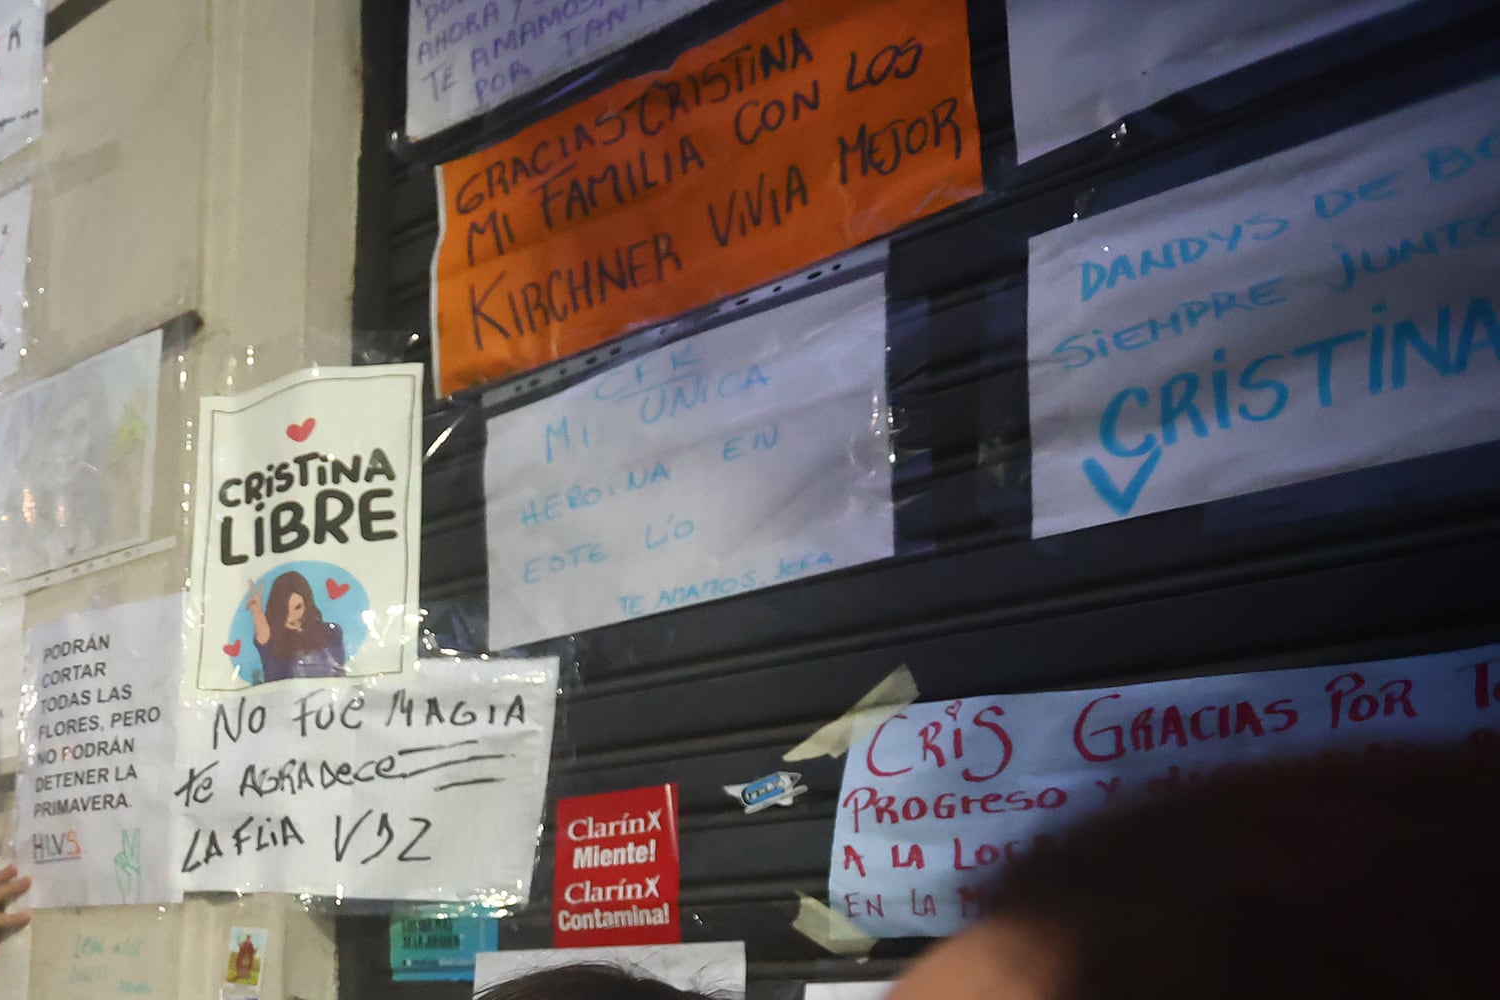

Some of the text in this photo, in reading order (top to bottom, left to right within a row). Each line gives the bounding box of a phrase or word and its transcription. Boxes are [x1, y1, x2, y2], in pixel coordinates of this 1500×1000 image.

[457, 28, 813, 216] GRACIAS CRISTINA
[467, 37, 923, 266] MI FAMILIA CON LOS
[470, 98, 963, 350] KIRCHNER VIVIA MEJOR
[1080, 211, 1289, 302] DANDYS
[1313, 173, 1399, 219] DE
[1051, 277, 1287, 369] SIEMPRE
[1100, 296, 1500, 458] CRISTINA
[546, 416, 589, 464] MI
[722, 424, 780, 462] EN
[43, 633, 111, 662] PODRÁN
[41, 662, 107, 689] CORTAR
[40, 684, 133, 714] TODAS LAS
[110, 706, 161, 728] PERO
[212, 697, 267, 750] NO
[385, 688, 526, 728] MAGIA
[866, 702, 1014, 783] CRIS
[1325, 672, 1419, 730] POR
[37, 735, 135, 767] NO PODRÁN
[35, 763, 138, 793] DETENER LA
[572, 838, 657, 870] Miente!
[843, 844, 867, 877] A
[891, 843, 926, 870] LA
[557, 901, 670, 932] Contamina!
[844, 892, 884, 918] EN
[911, 888, 937, 918] LA
